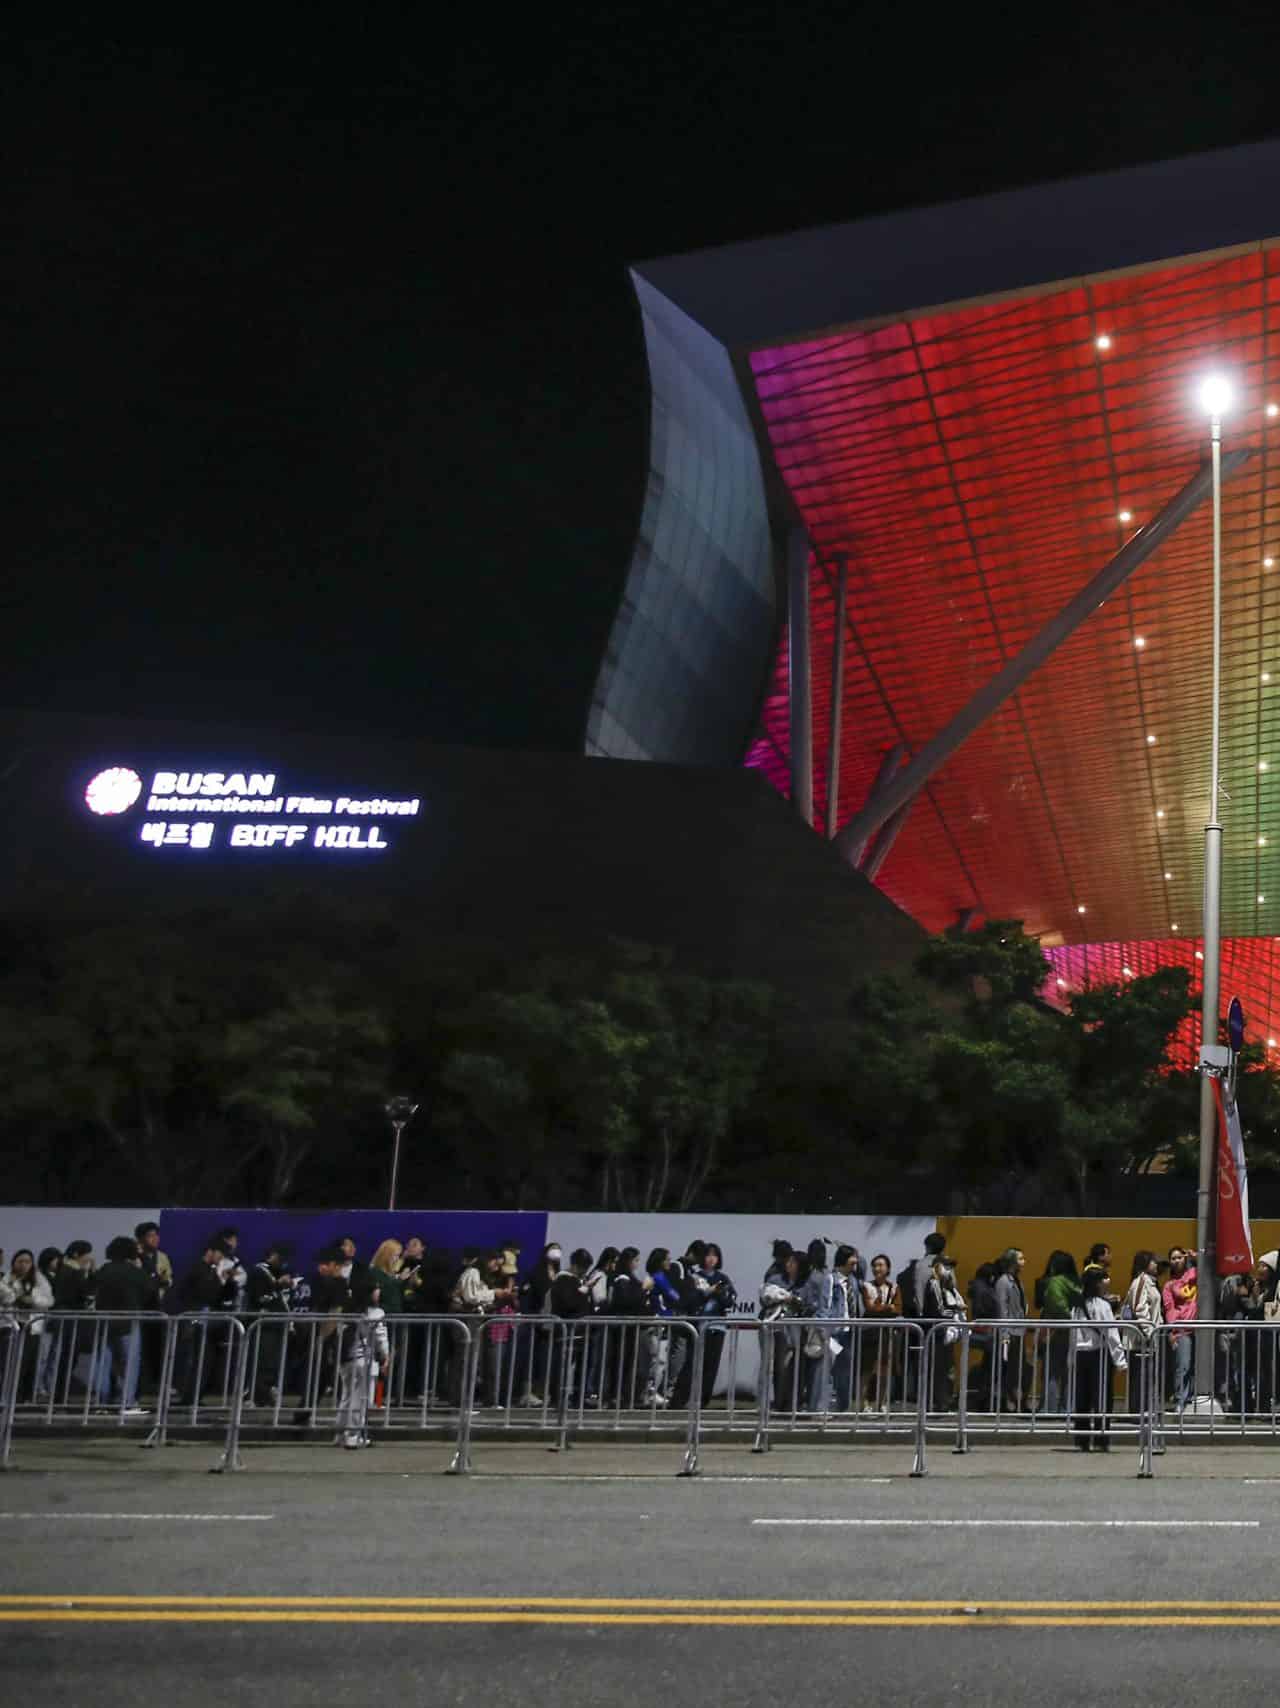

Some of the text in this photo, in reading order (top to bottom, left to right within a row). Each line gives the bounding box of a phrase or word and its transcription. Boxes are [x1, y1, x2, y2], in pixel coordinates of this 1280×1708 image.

[151, 772, 275, 795] BUSAN
[147, 796, 419, 815] International Film Festival
[231, 825, 387, 848] BIFF HILL
[727, 1302, 754, 1313] NM
